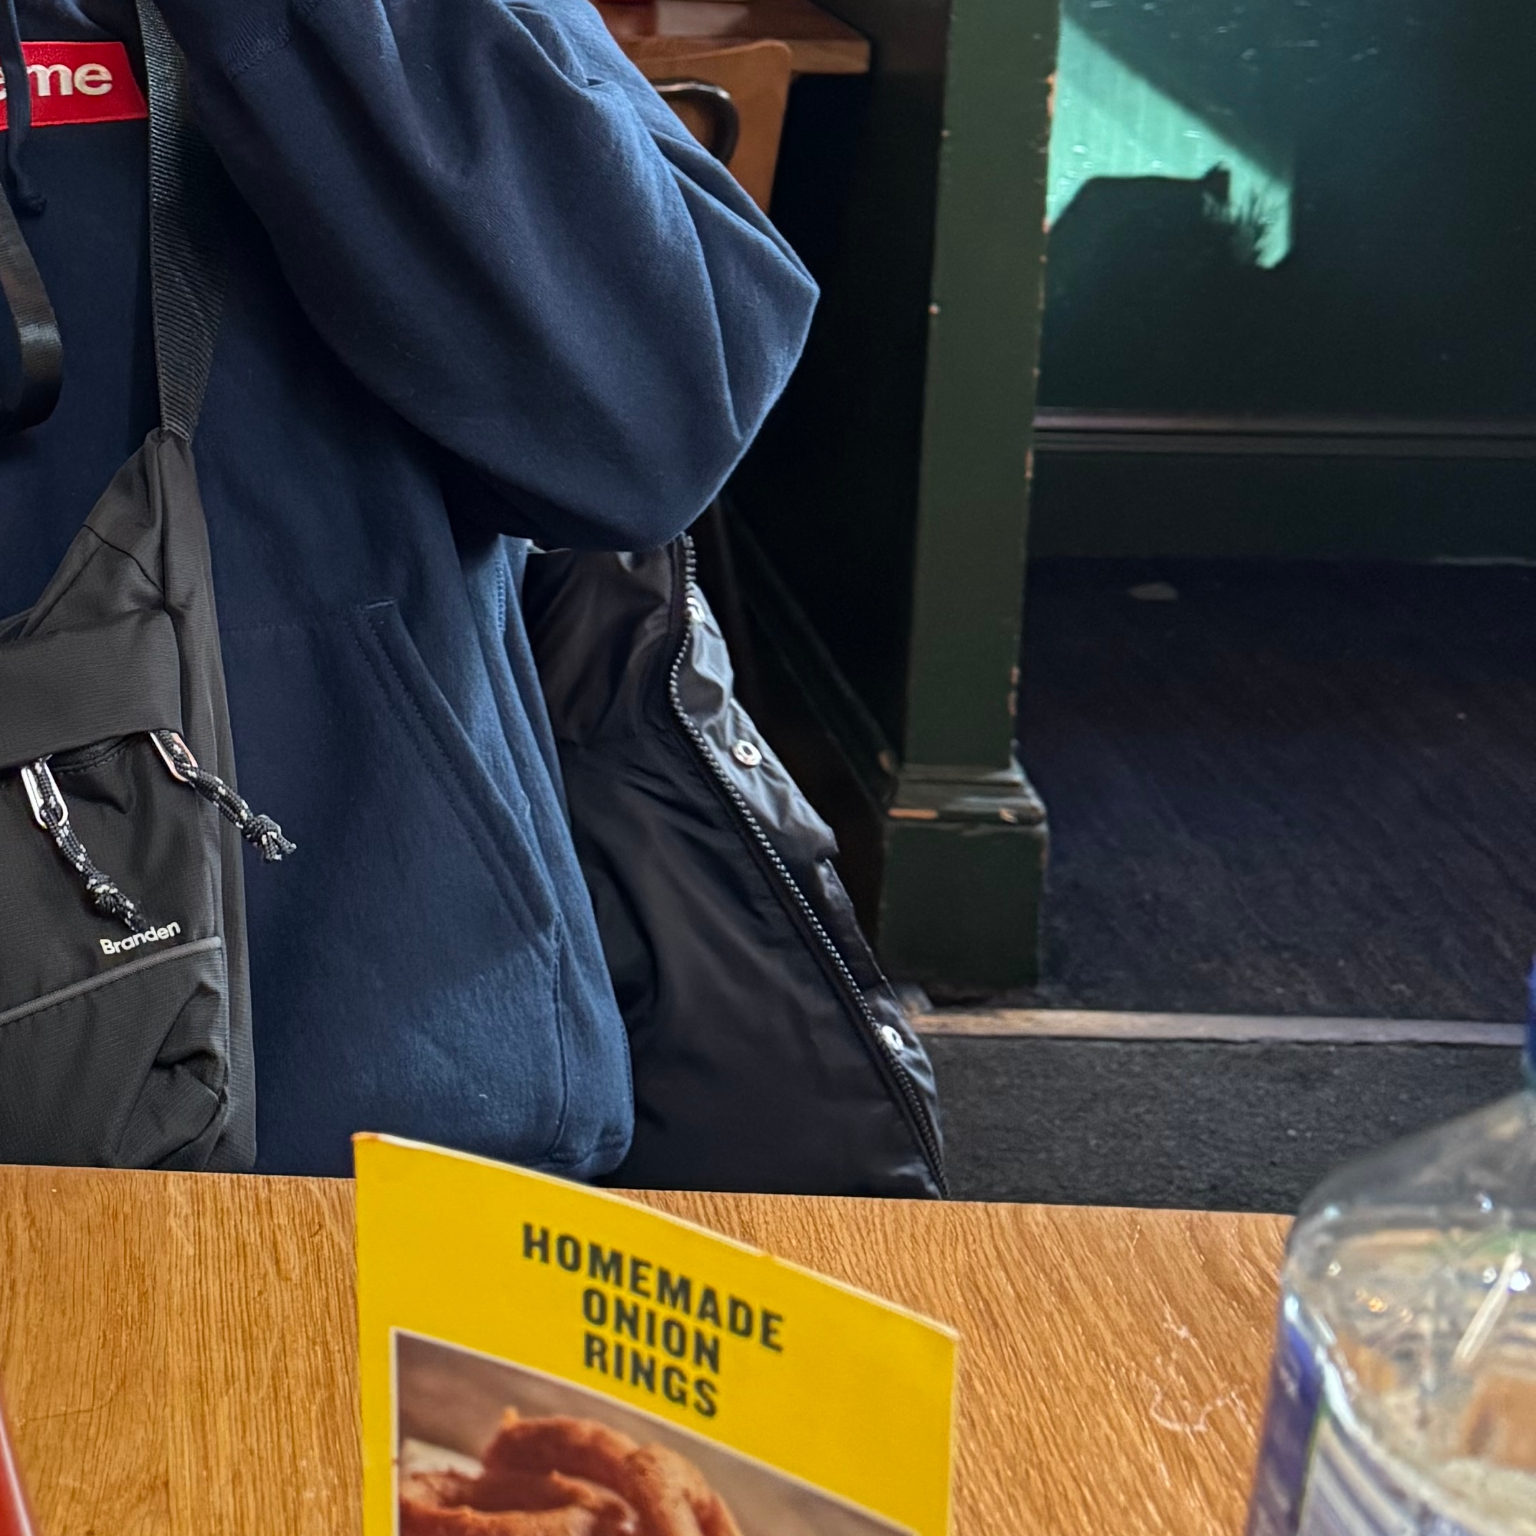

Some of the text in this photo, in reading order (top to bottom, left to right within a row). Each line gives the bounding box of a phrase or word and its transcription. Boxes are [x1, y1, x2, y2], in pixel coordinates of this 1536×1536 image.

[100, 921, 181, 955] Branden
[522, 1223, 784, 1352] HOMEMADE
[582, 1288, 720, 1375] ONION
[583, 1331, 718, 1419] RINGS
